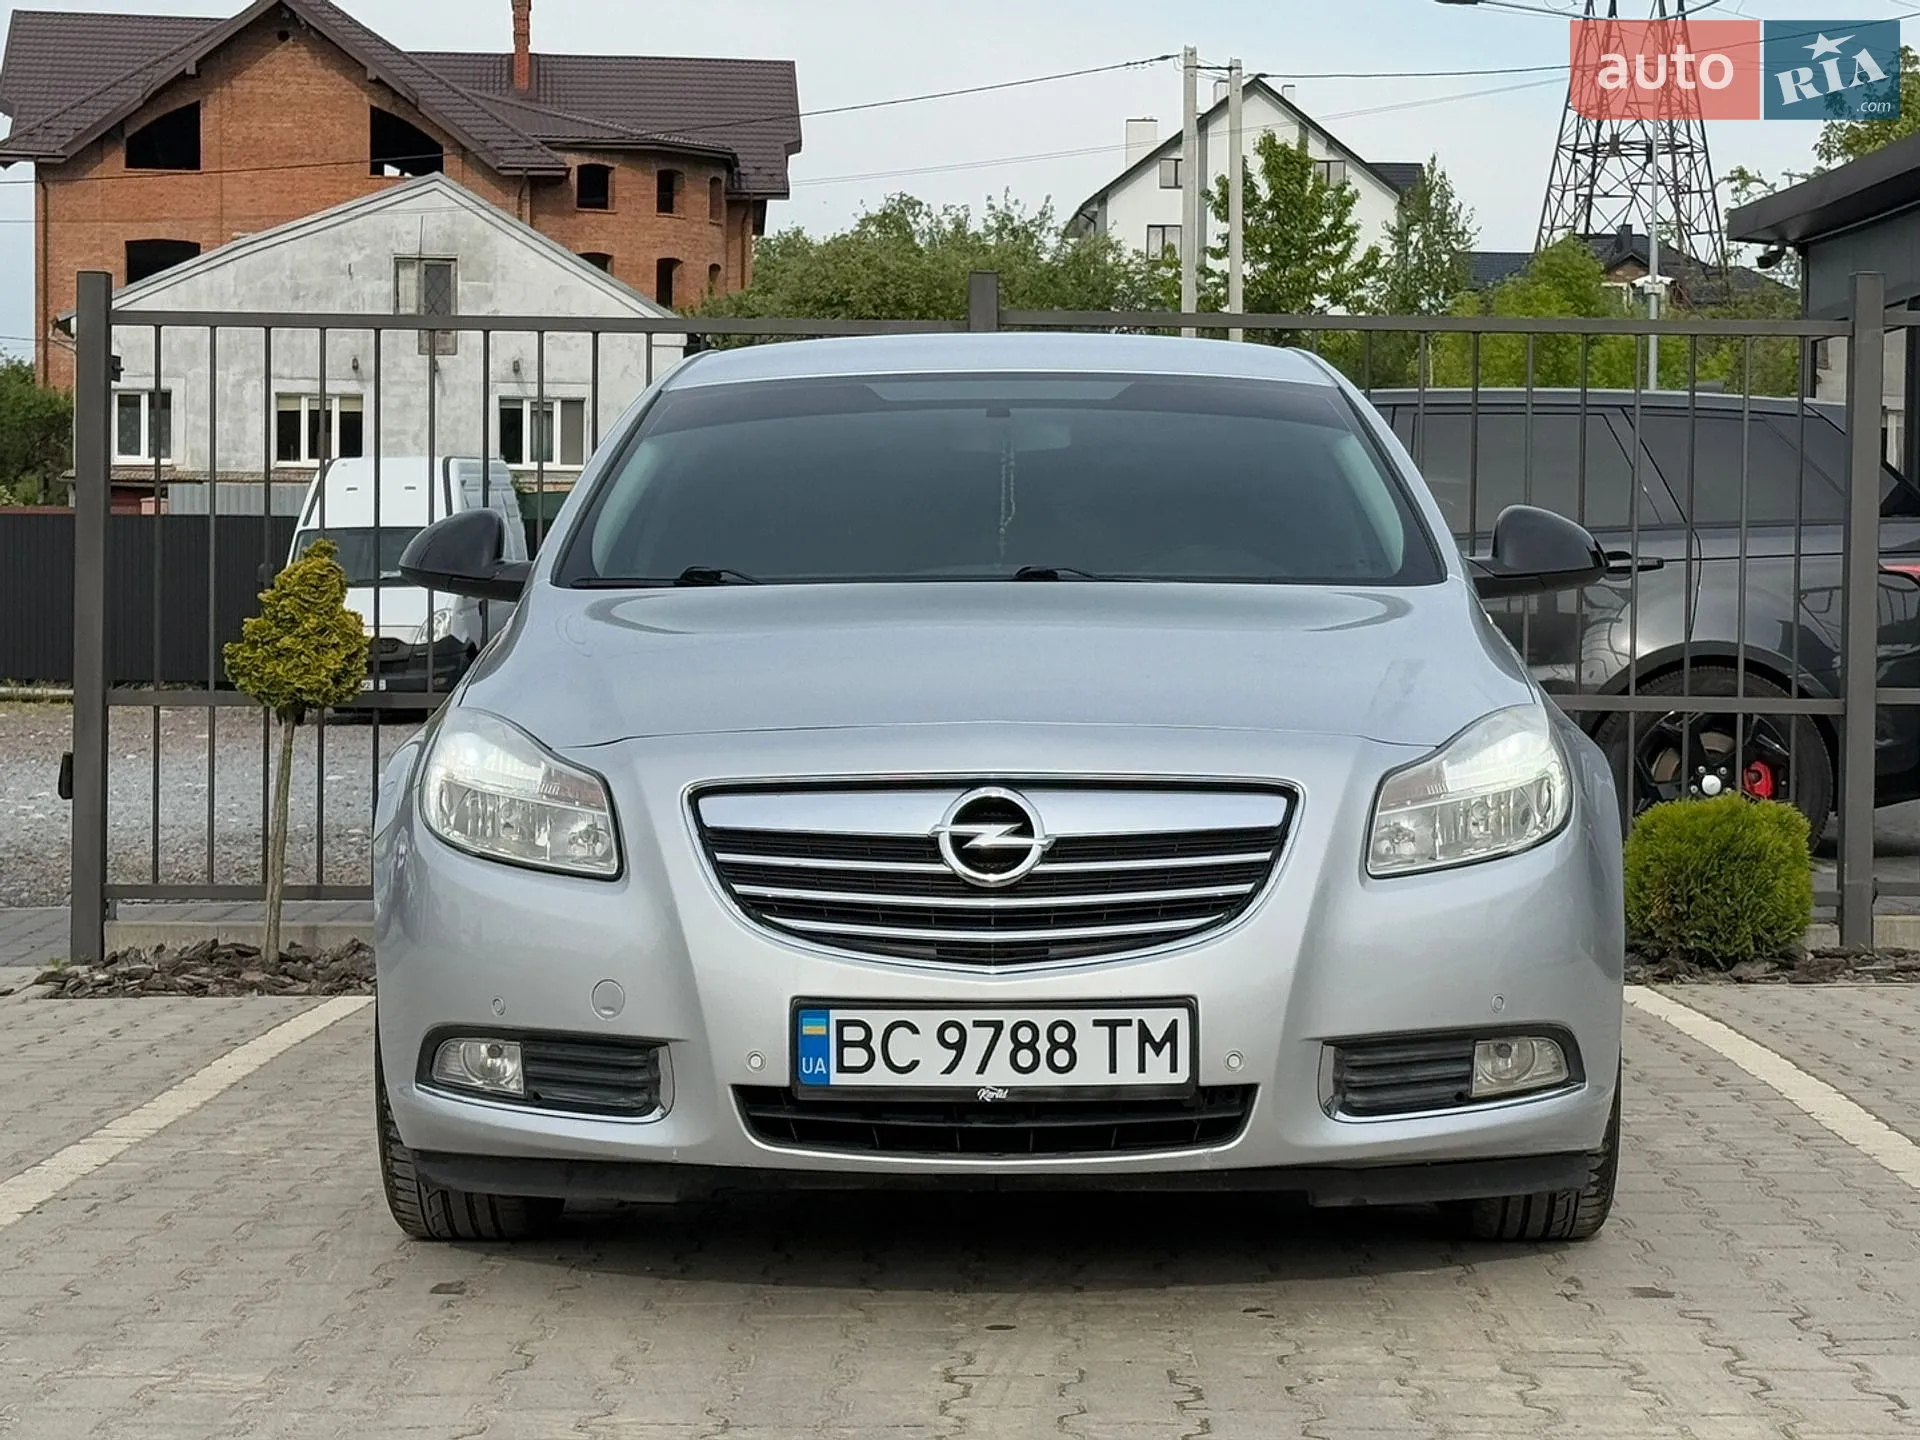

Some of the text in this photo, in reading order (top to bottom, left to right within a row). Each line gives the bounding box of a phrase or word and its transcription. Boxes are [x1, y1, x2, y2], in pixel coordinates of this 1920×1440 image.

[836, 1018, 1178, 1075] BC 9788 TM
[802, 1057, 827, 1074] UA
